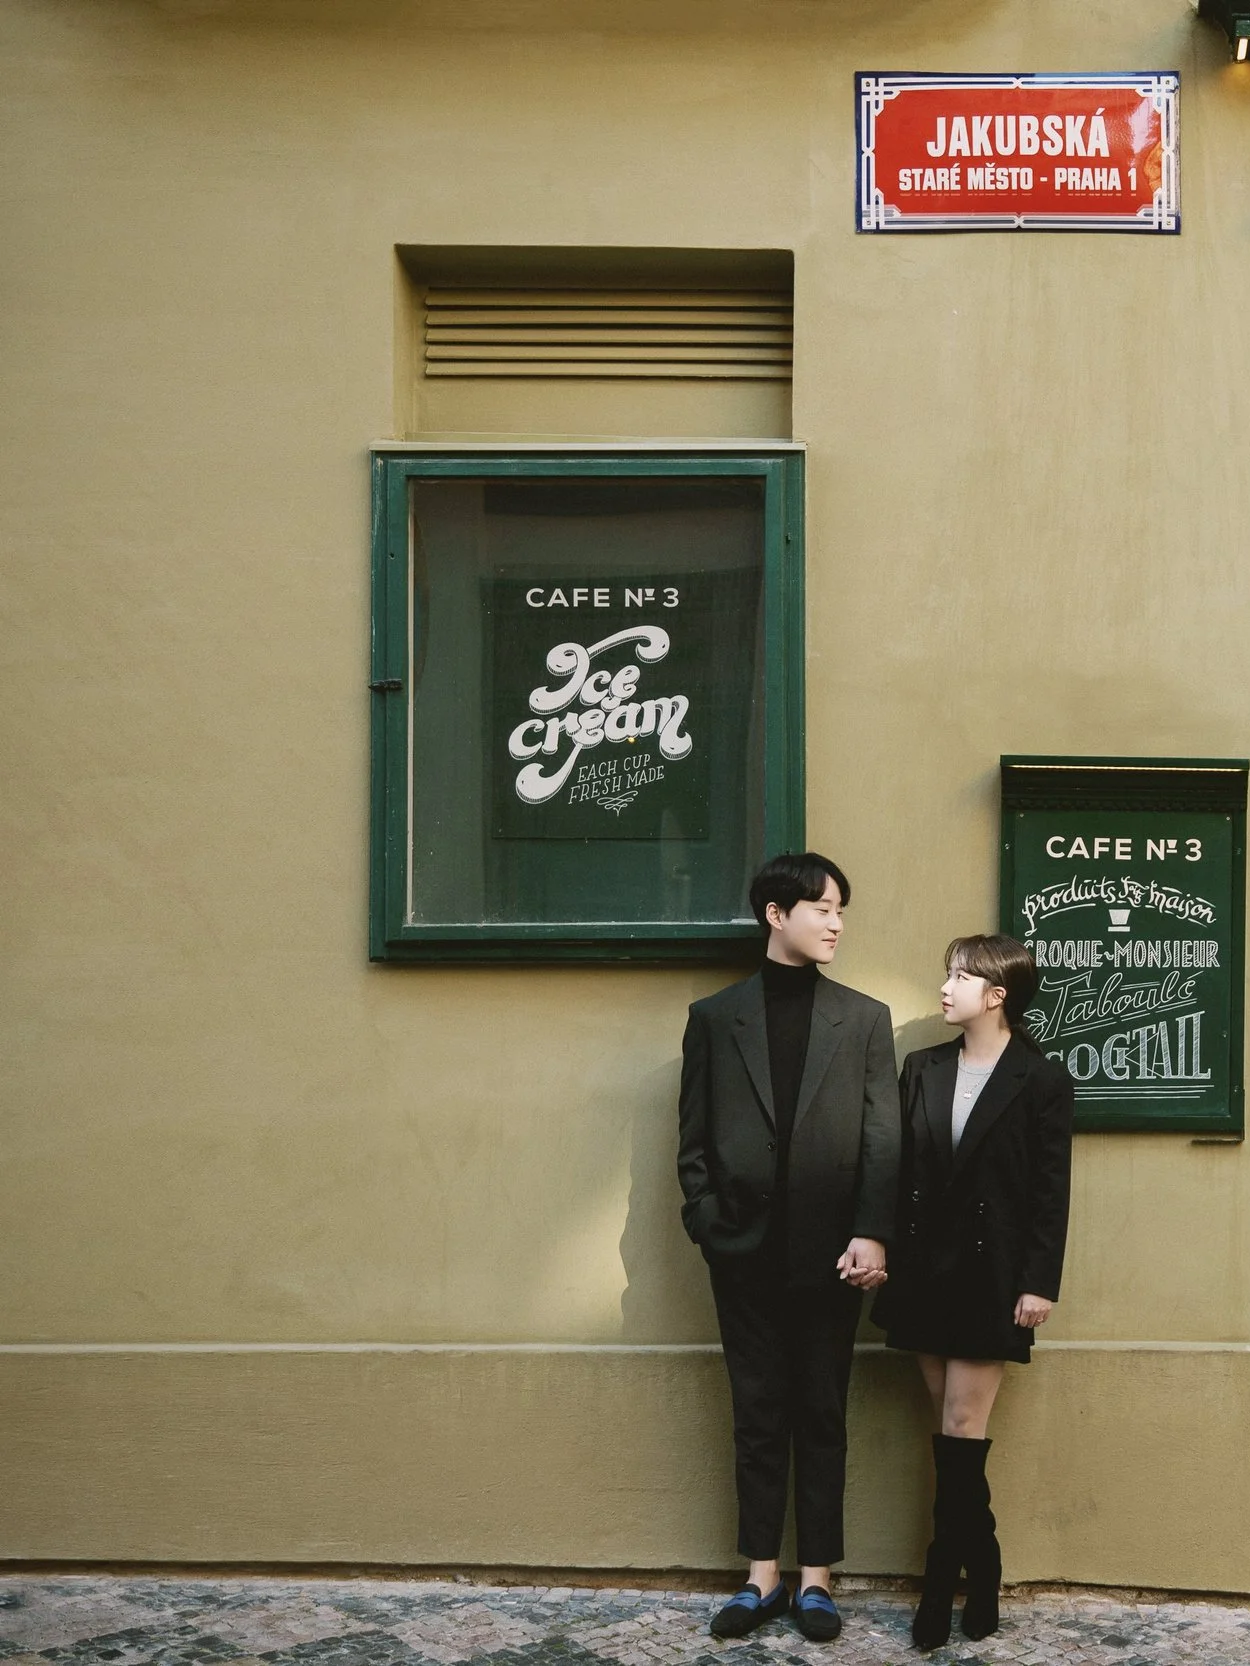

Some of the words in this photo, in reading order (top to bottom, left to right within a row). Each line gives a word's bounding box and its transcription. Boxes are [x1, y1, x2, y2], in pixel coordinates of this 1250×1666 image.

[926, 108, 1110, 158] JAKUBSKÁ
[899, 163, 961, 191] STARÉ
[968, 162, 1033, 191] MĚSTO
[1055, 167, 1122, 191] PRAHA
[1127, 167, 1137, 191] 1
[526, 587, 610, 608] CAFE
[663, 587, 679, 608] 3
[529, 625, 670, 715] Ice
[508, 694, 693, 804] cream
[577, 761, 617, 783] EACH
[623, 753, 651, 771] CUP
[567, 778, 621, 804] FRESH
[626, 765, 665, 788] MADE
[1045, 835, 1132, 861] CAFE
[1184, 838, 1202, 862] 3
[1022, 874, 1116, 937] produits
[1150, 880, 1217, 924] maison
[1039, 970, 1204, 1043] Taboulé
